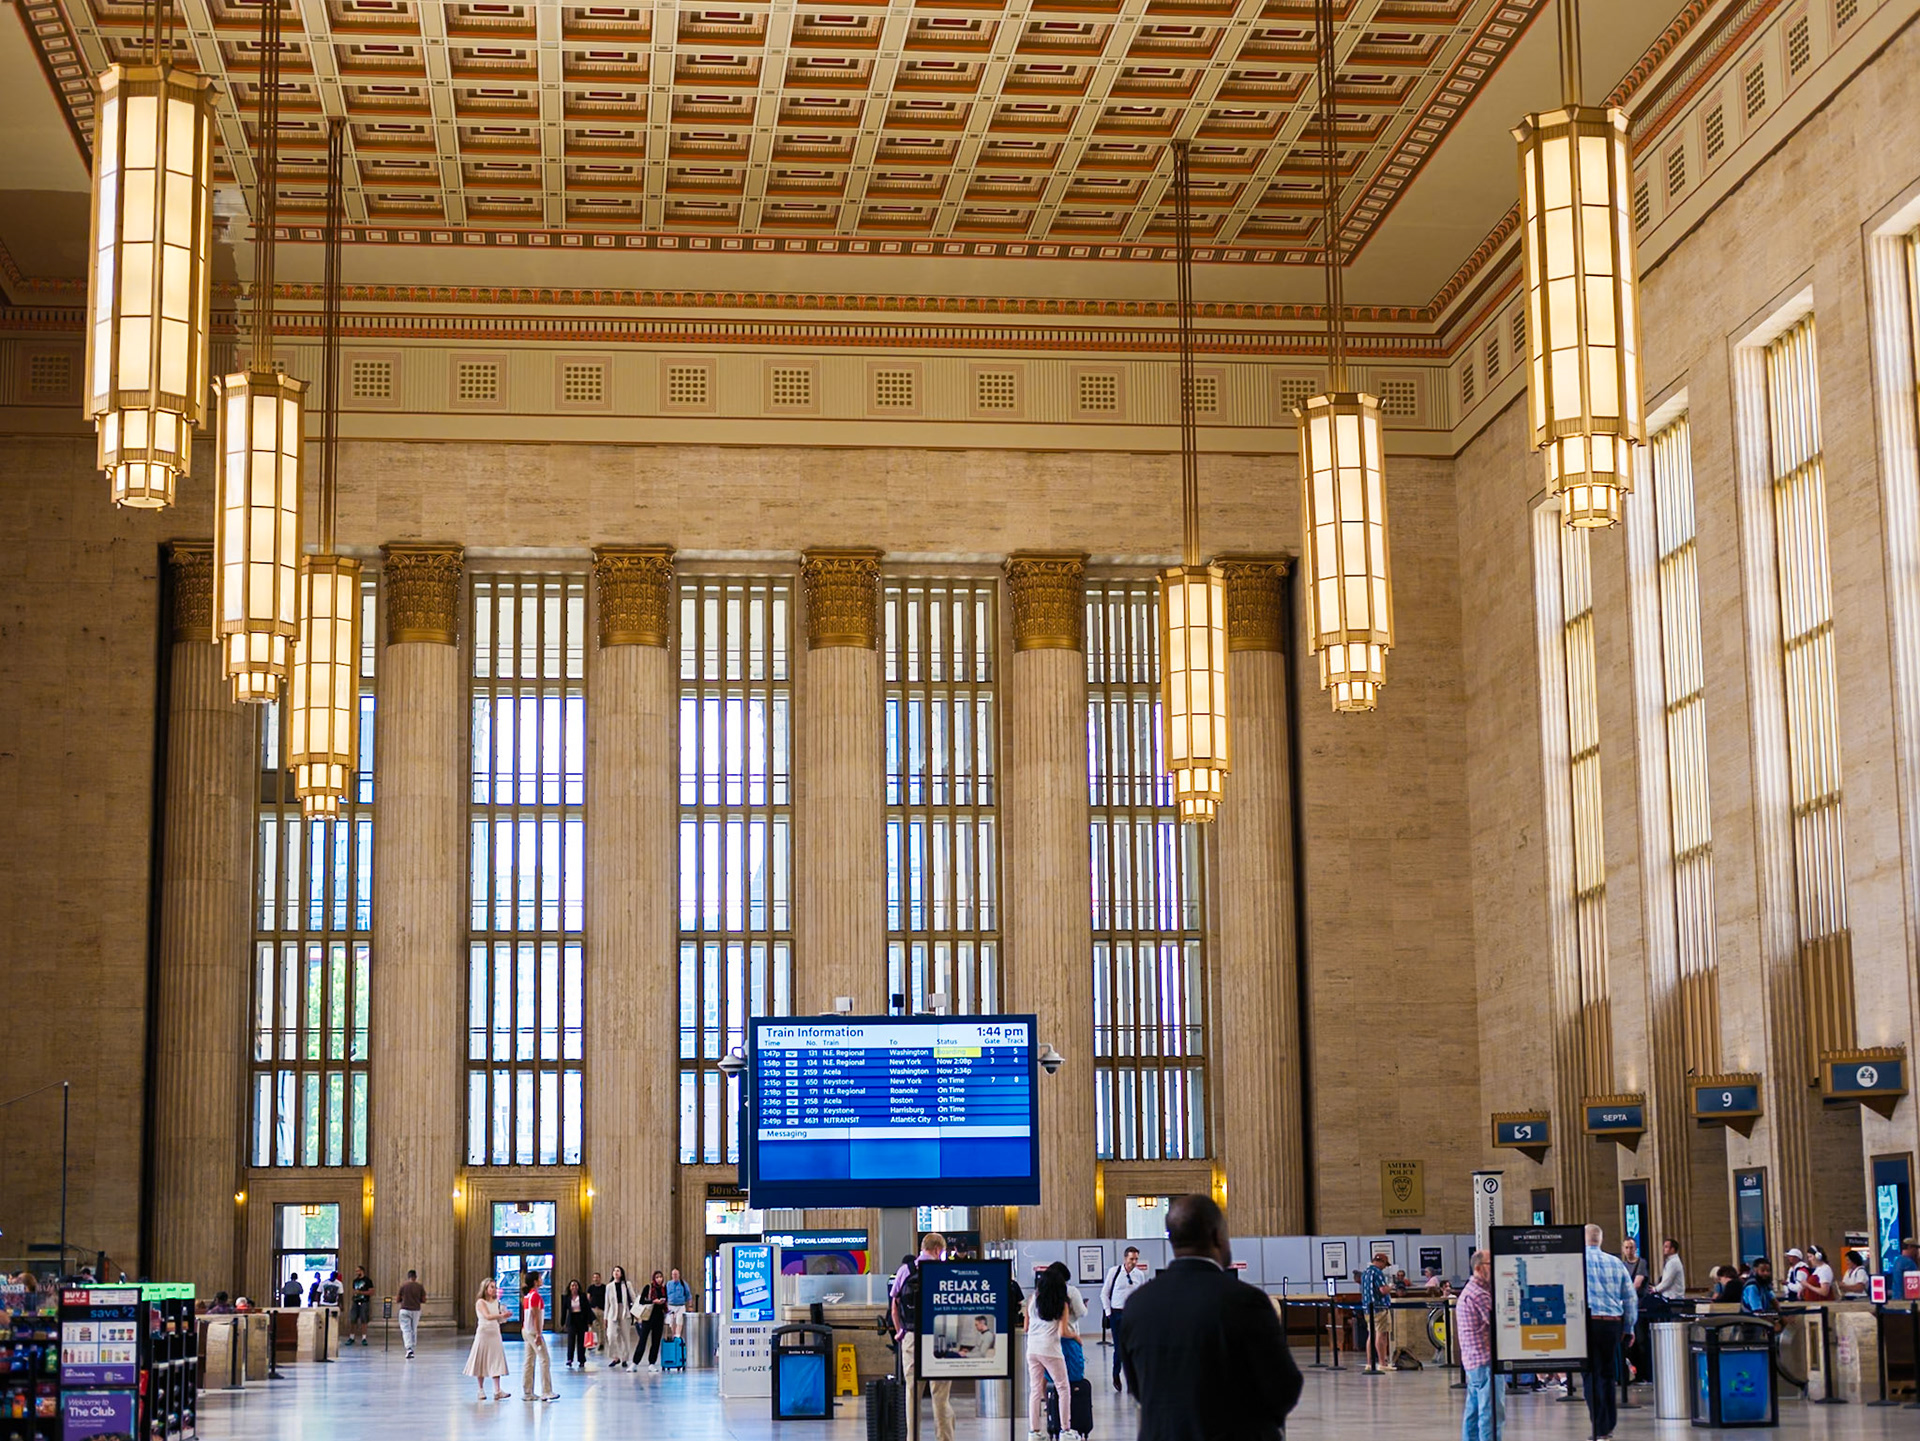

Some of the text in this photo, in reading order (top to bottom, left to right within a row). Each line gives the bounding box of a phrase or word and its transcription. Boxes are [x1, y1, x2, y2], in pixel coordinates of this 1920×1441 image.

[766, 1026, 864, 1037] Train Information
[977, 1027, 1023, 1038] 1:44 pm
[1722, 1092, 1732, 1107] 9
[1602, 1114, 1628, 1122] SEPTA
[738, 1260, 755, 1270] Day
[738, 1270, 762, 1279] here.
[939, 1280, 990, 1292] RELAX &
[933, 1293, 996, 1304] RECHARGE
[90, 1307, 135, 1318] save $2
[70, 1407, 115, 1416] The Club
